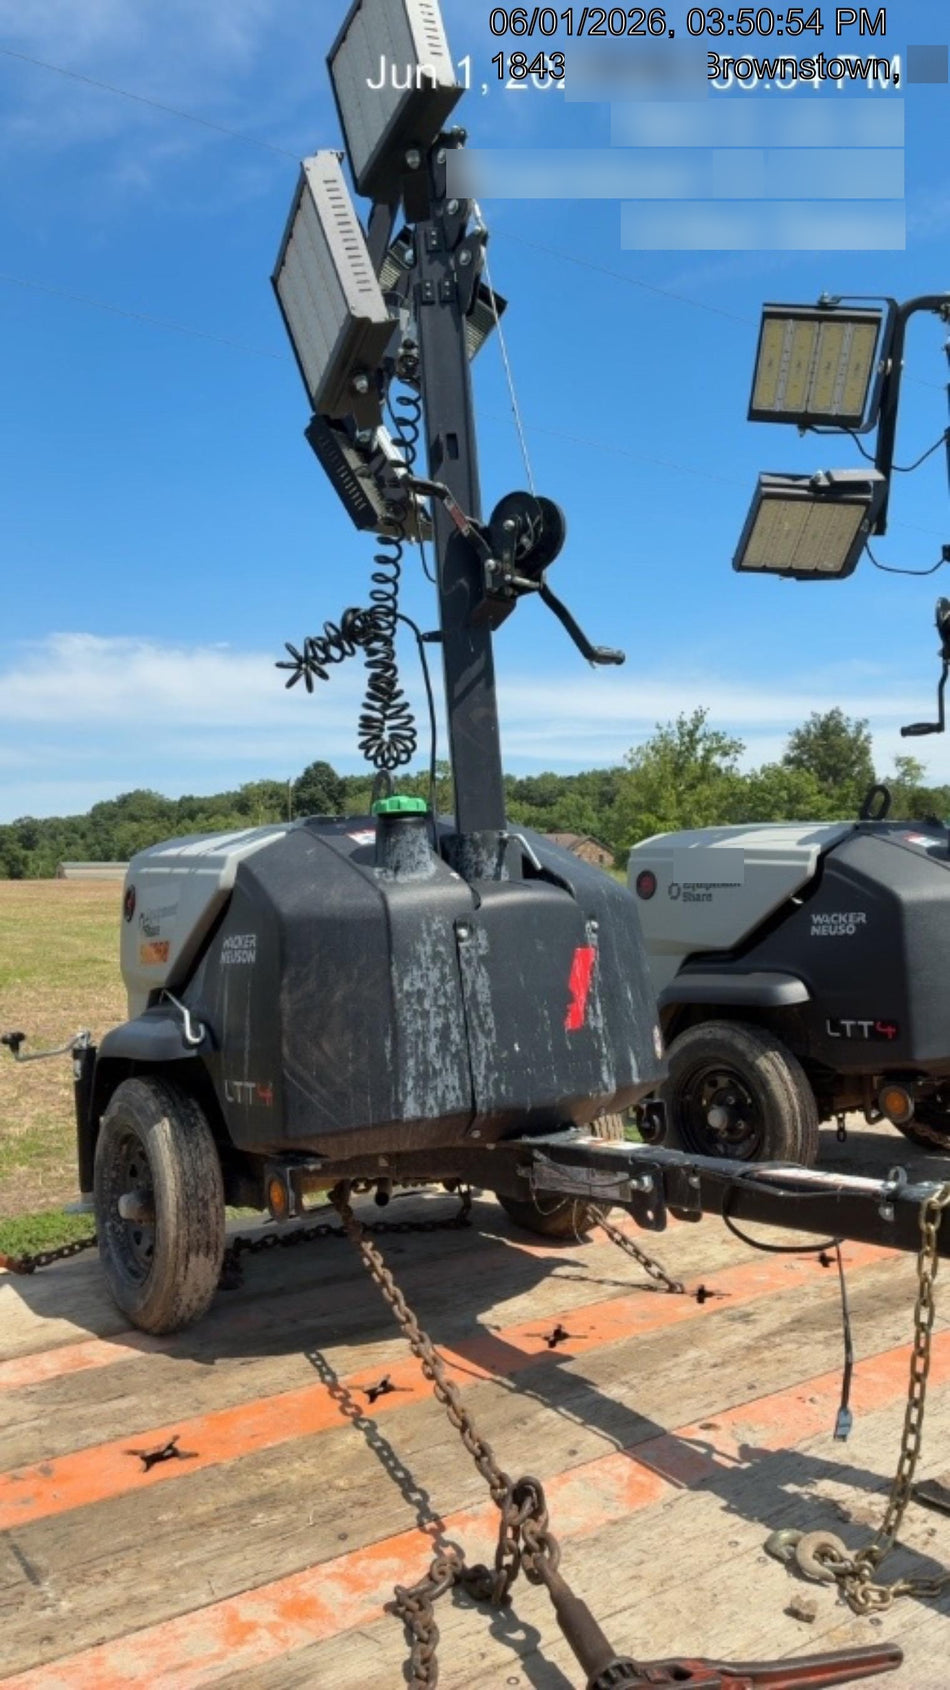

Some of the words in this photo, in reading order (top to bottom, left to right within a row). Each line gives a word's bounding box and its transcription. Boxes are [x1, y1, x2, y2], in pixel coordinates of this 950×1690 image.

[811, 912, 867, 925] WACKER
[221, 949, 257, 964] NEUSON
[825, 1019, 897, 1039] LTT4
